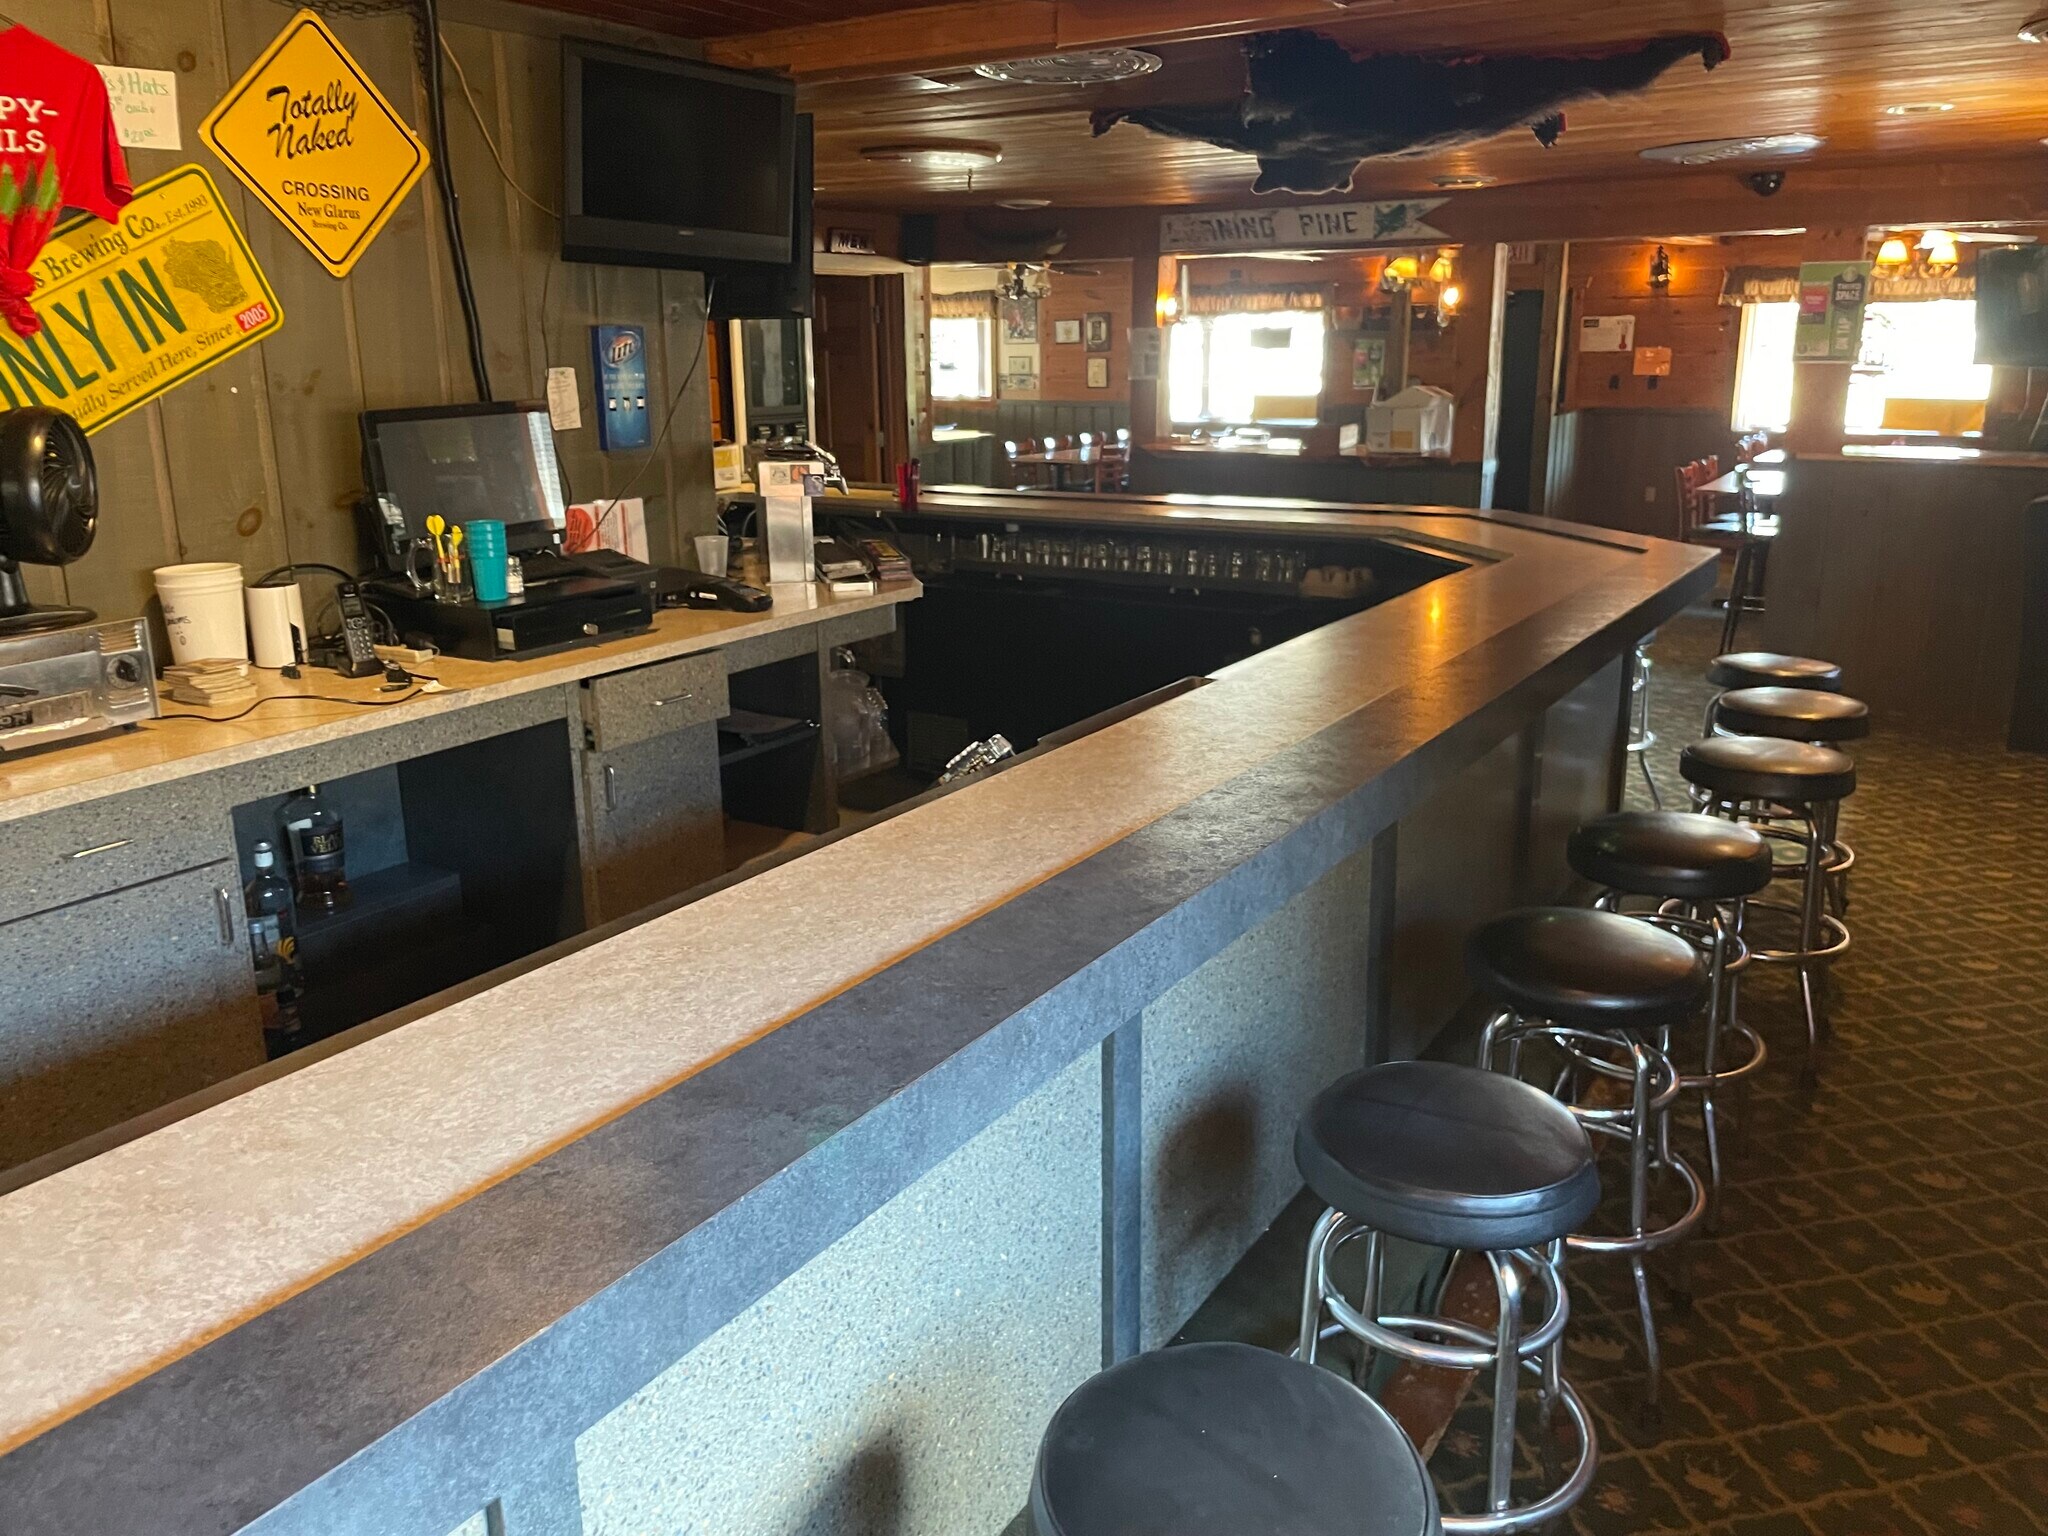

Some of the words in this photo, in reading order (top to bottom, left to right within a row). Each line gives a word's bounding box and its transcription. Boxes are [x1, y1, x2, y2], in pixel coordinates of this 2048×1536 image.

[126, 71, 170, 96] Hats
[266, 79, 358, 123] Totally
[0, 129, 47, 153] LS
[267, 116, 354, 159] Naked
[282, 180, 370, 201] CROSSING
[297, 201, 321, 217] New
[324, 203, 361, 219] Glarus
[1299, 211, 1358, 236] PINE
[40, 233, 129, 281] Brewing
[100, 256, 188, 354] IN
[72, 393, 108, 420] udly
[107, 358, 158, 400] Served
[159, 346, 198, 373] Here,
[196, 323, 233, 351] Since
[238, 303, 268, 330] 2005
